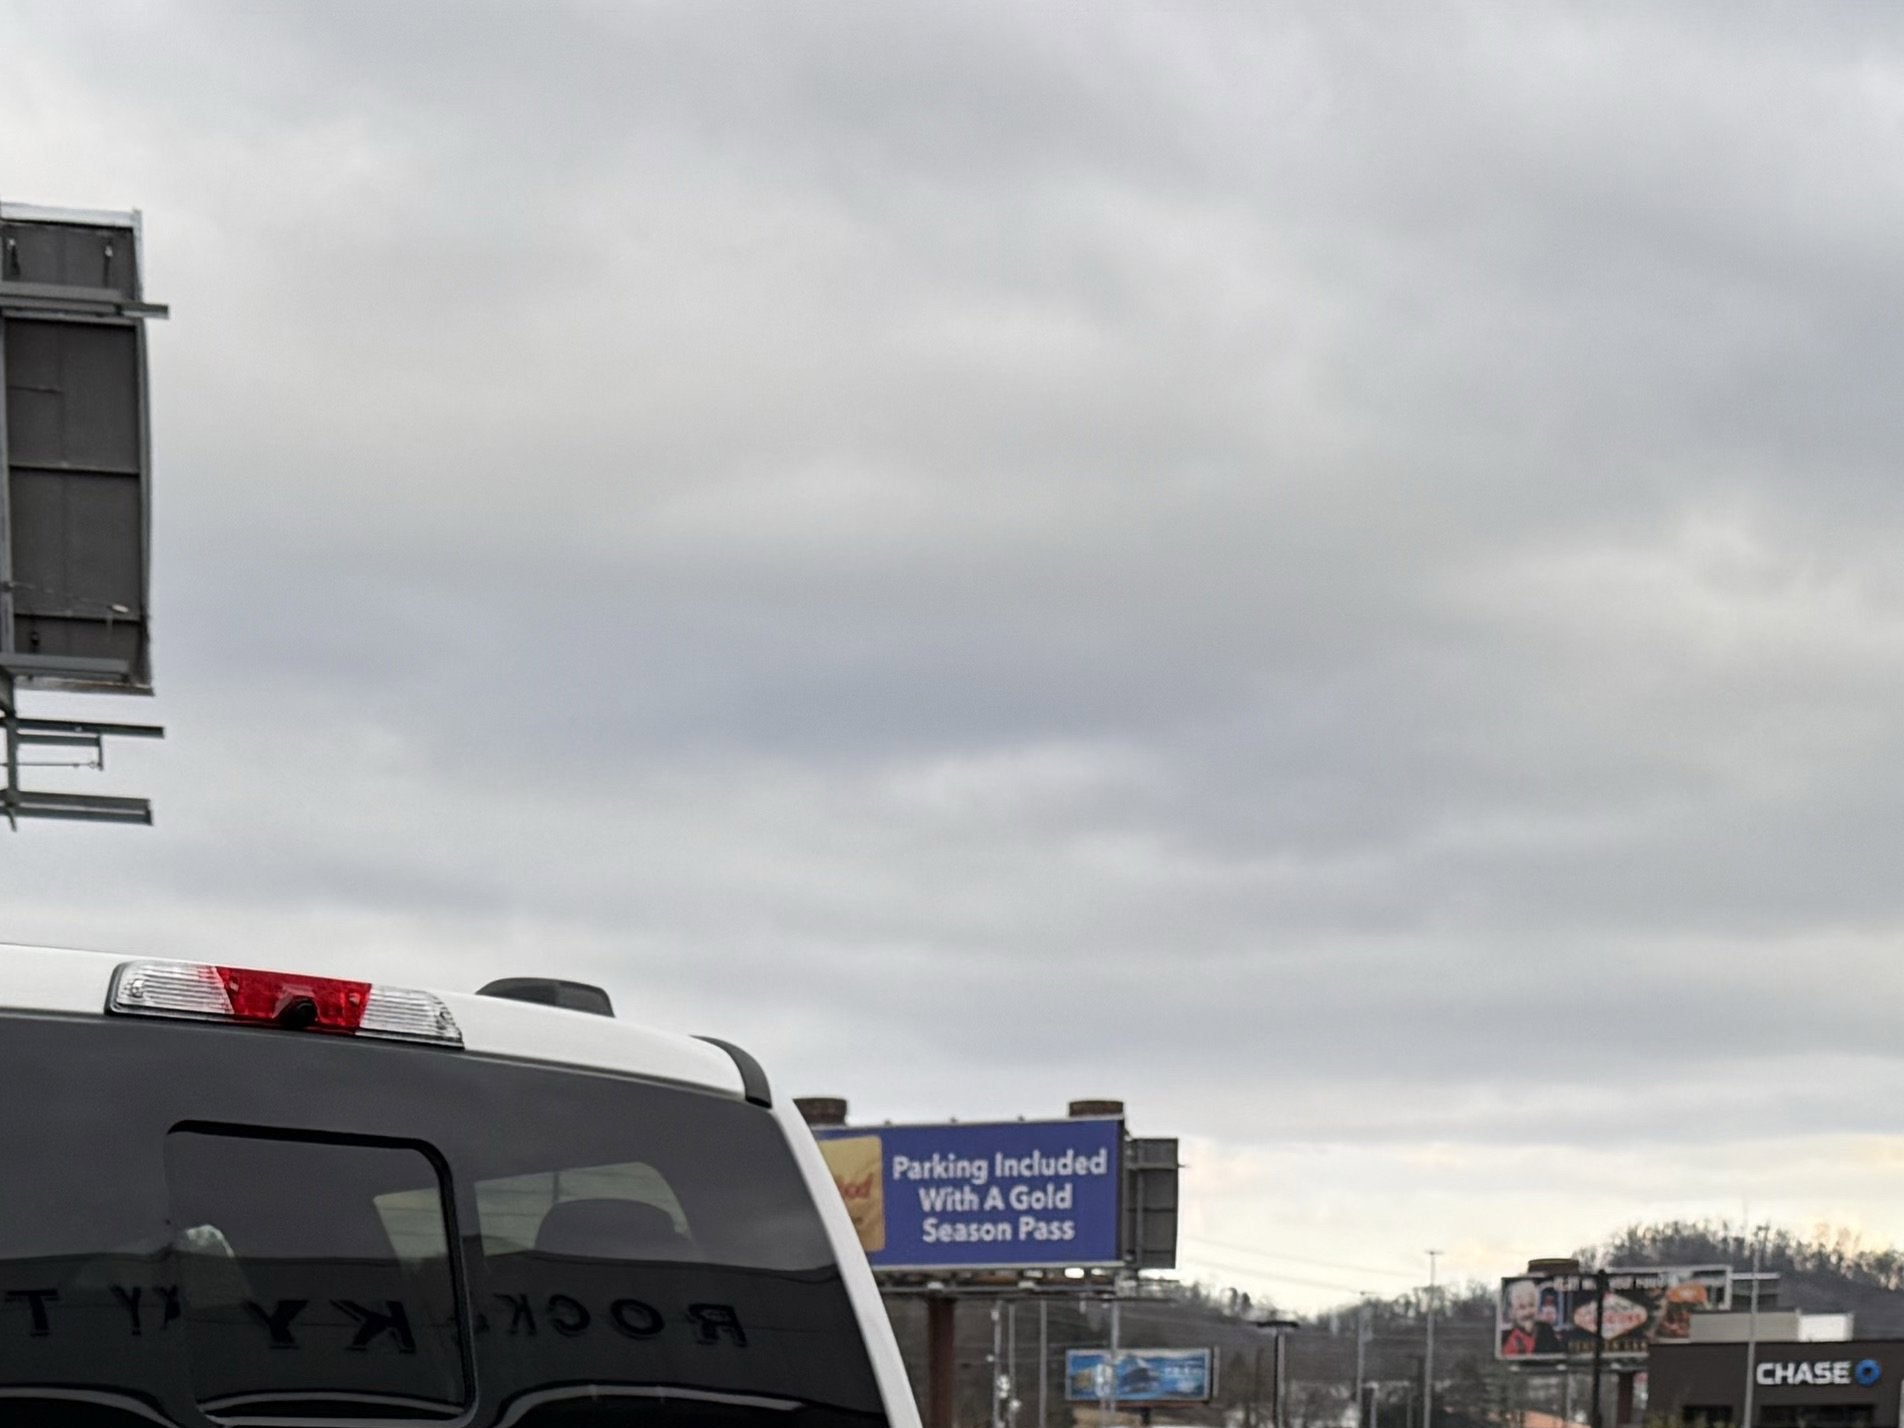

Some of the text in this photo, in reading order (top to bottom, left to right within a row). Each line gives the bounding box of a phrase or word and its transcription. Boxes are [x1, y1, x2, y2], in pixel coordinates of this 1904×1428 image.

[892, 1148, 1108, 1183] Parking Included
[918, 1184, 1073, 1212] With A Gold
[922, 1217, 1075, 1243] Season Pass
[1755, 1360, 1852, 1386] CHASE
